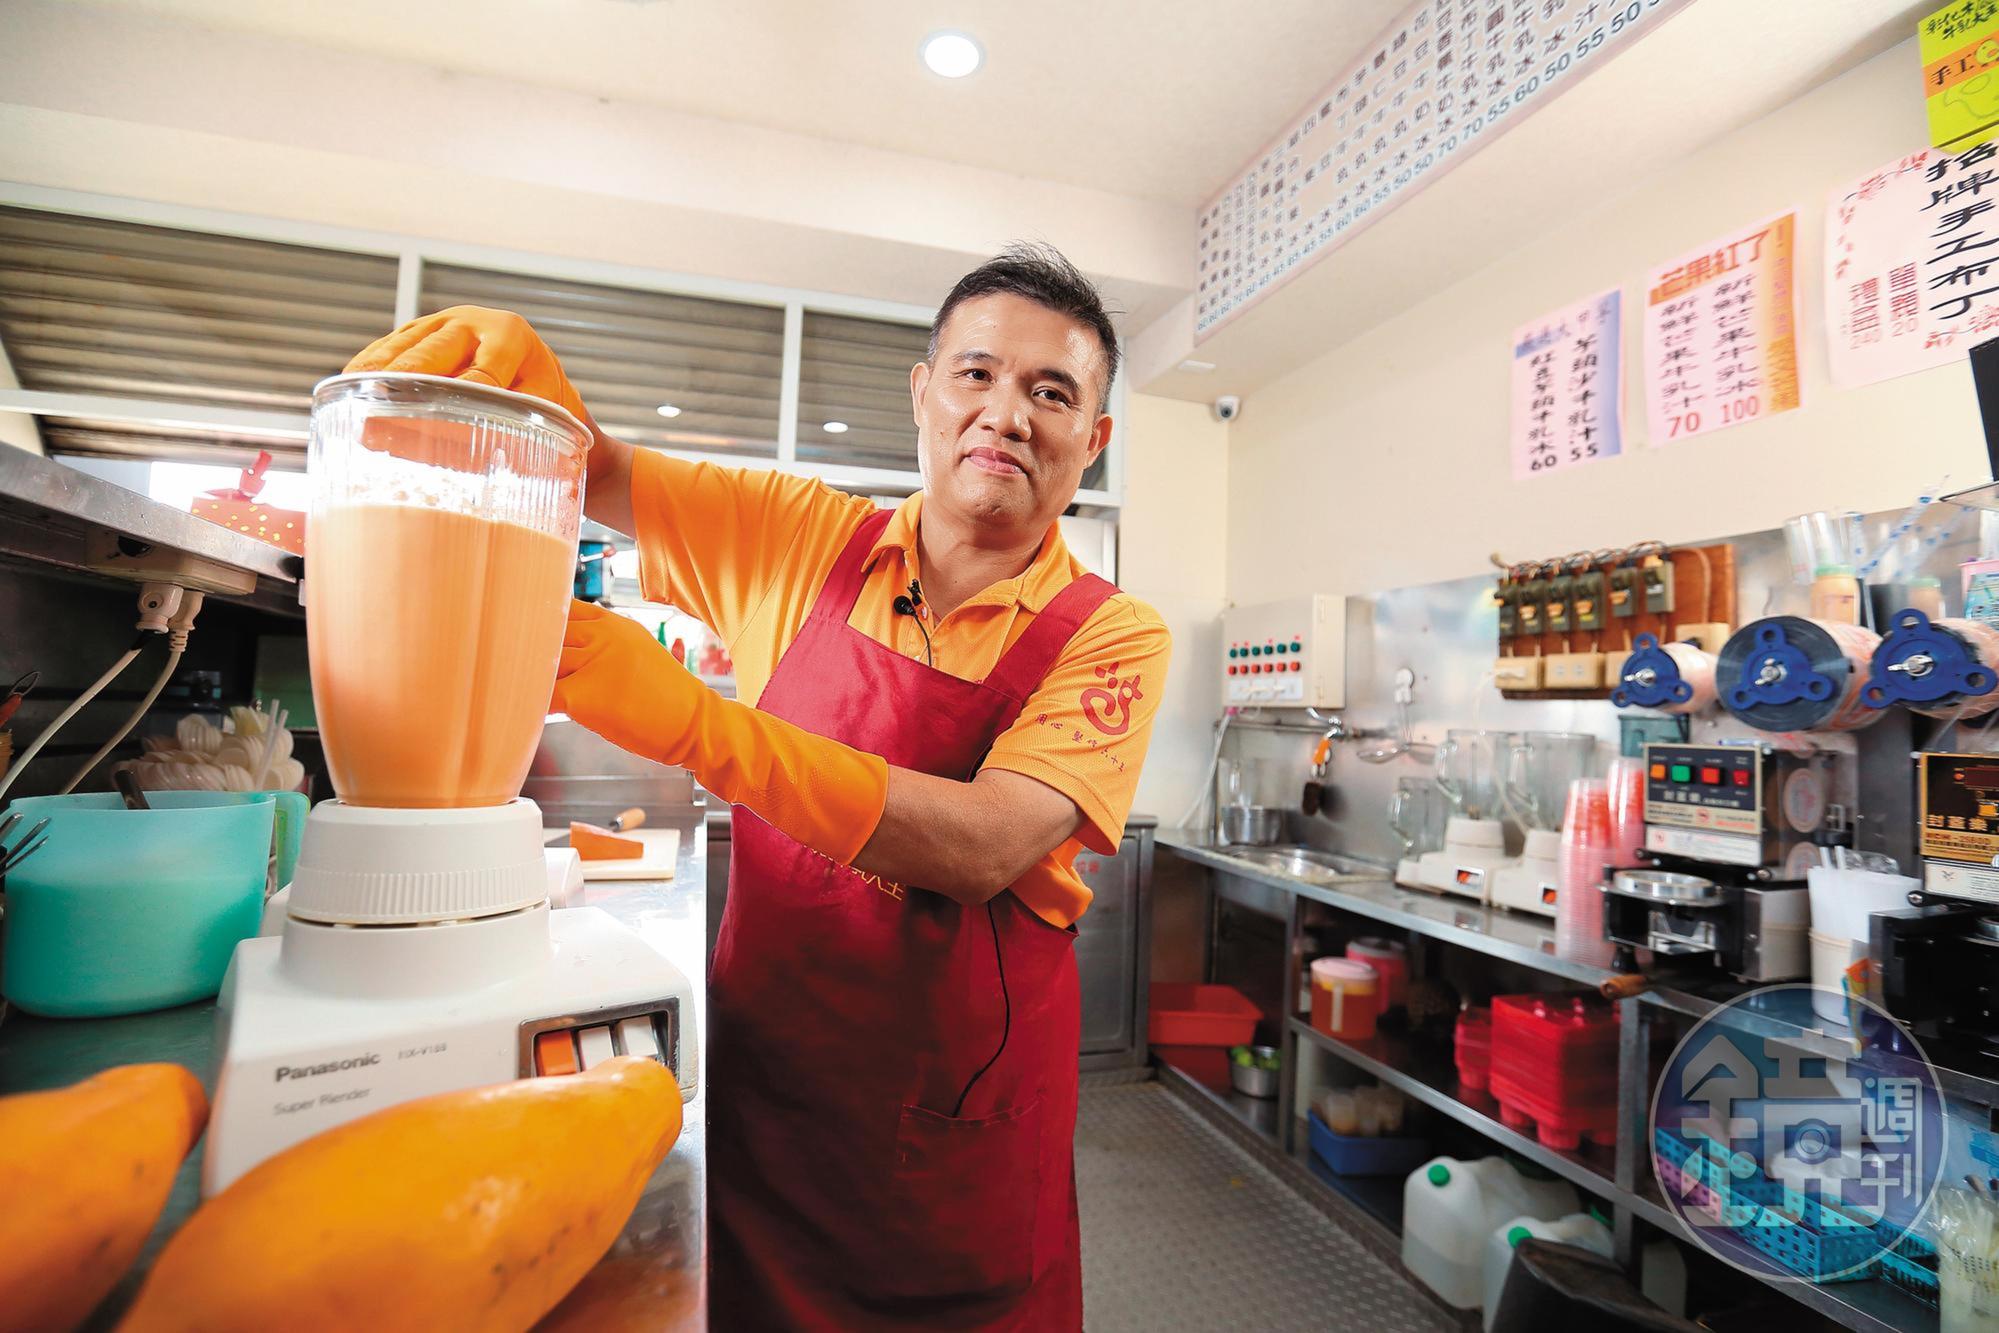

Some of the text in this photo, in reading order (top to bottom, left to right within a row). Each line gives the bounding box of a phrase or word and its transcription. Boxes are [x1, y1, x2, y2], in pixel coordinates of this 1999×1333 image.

[1611, 1, 1640, 34] 50
[1577, 27, 1604, 58] 55
[1545, 52, 1570, 82] 50
[1514, 76, 1539, 102] 60
[1488, 96, 1510, 122] 55
[1463, 117, 1484, 140] 70
[1438, 135, 1457, 157] 70
[1414, 153, 1434, 174] 50
[1393, 168, 1412, 190] 50
[1919, 140, 1999, 321] 招牌手工布丁
[1891, 318, 1919, 337] 20
[1721, 395, 1760, 424] 100
[1667, 412, 1700, 438] 70
[1530, 454, 1557, 471] 60
[1570, 442, 1598, 462] 55
[275, 1053, 381, 1083] Panasonic
[273, 1099, 315, 1117] Super
